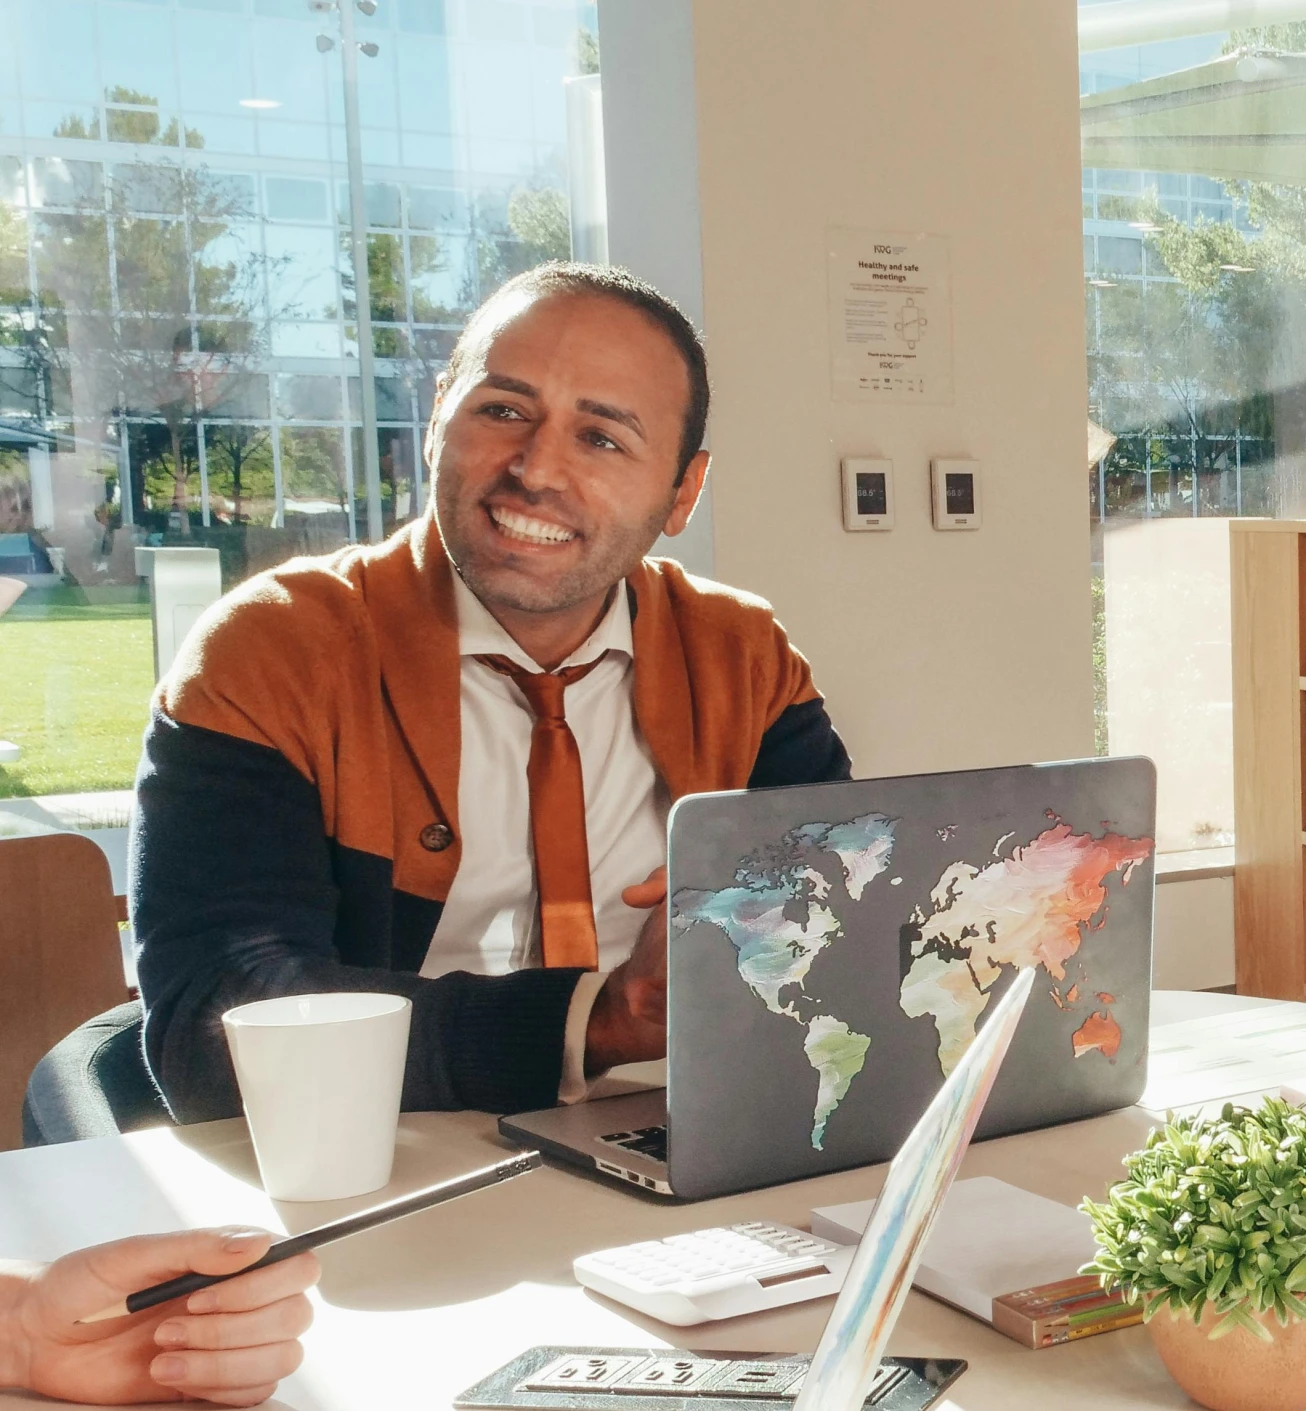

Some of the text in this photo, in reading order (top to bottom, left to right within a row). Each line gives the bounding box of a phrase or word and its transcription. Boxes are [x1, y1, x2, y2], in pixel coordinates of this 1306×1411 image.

[858, 261, 919, 272] Healthy and safe
[872, 272, 907, 283] meetings
